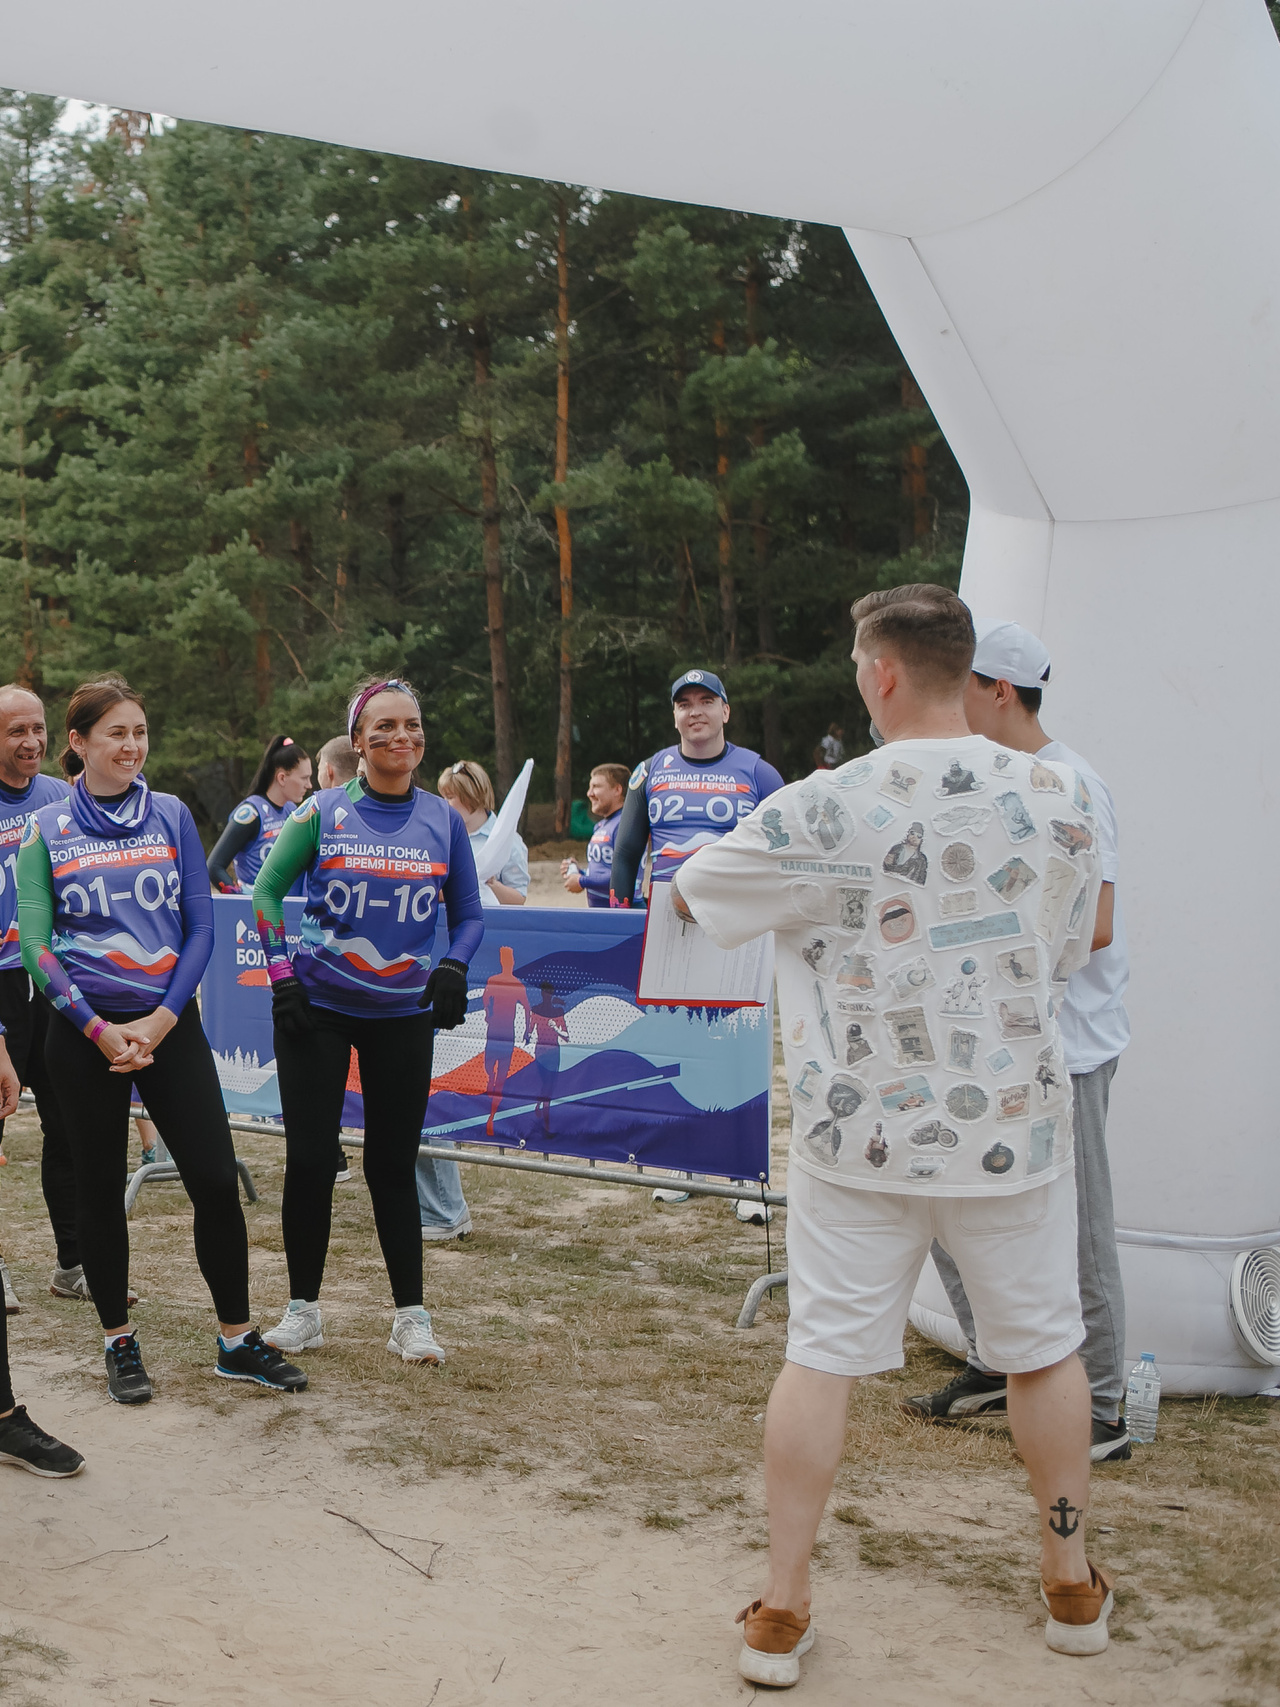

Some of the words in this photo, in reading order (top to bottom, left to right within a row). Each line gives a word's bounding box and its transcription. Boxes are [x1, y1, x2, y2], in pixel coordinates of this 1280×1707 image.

[651, 774, 700, 785] БОЛЬШАЯ
[701, 774, 736, 783] ГОНКА
[668, 781, 700, 790] ВРЕМЯ
[701, 782, 737, 792] ГЕРОЕВ
[648, 795, 755, 824] 02-05
[50, 834, 87, 846] Ростелеком
[323, 832, 358, 840] Ростелеком
[50, 841, 117, 863] БОЛЬШАЯ
[119, 833, 167, 850] ГОНКА
[78, 852, 122, 868] ВРЕМЯ
[122, 846, 169, 861] ГЕРОЕВ
[320, 843, 385, 857] БОЛЬШАЯ
[387, 846, 431, 861] ГОНКА
[344, 857, 386, 870] ВРЕМЯ
[388, 859, 433, 874] ГЕРОЕВ
[780, 860, 825, 874] HAKUNA
[827, 864, 873, 878] MATATA
[61, 868, 181, 918] 01-02
[324, 879, 437, 923] 01-10
